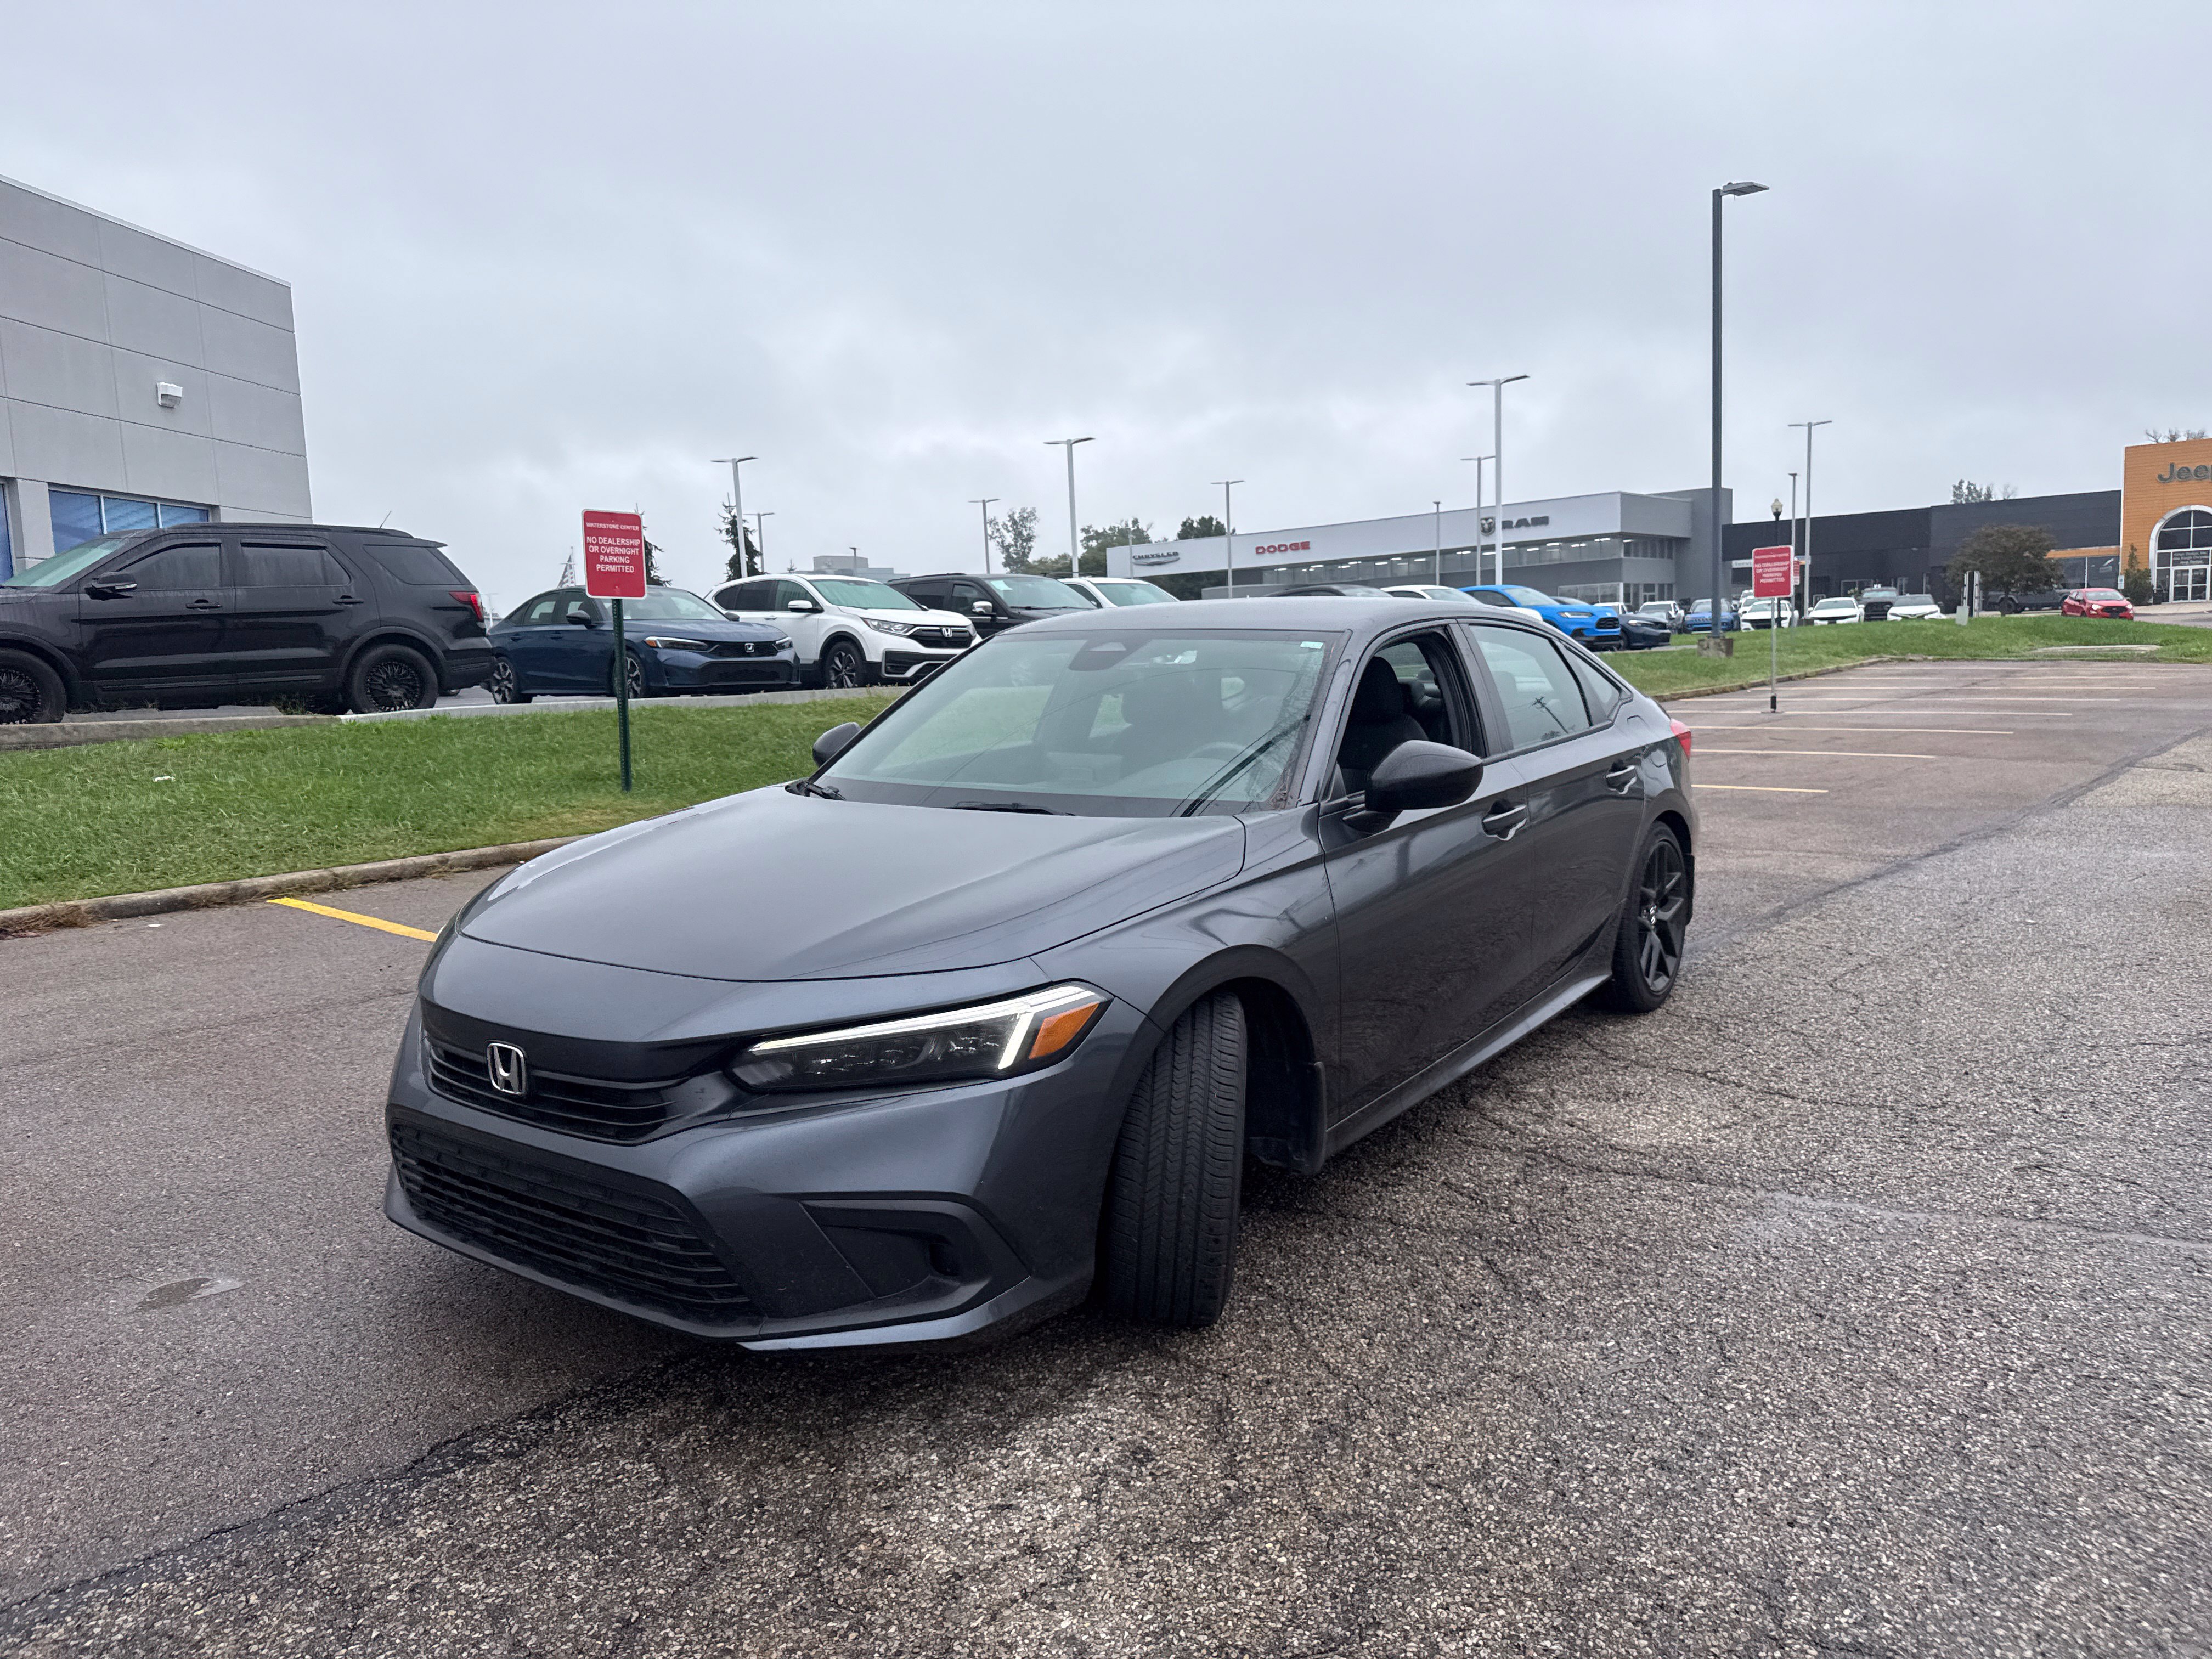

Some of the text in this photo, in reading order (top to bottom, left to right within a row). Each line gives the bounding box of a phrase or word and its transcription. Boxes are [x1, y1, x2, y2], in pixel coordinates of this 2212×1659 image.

[2157, 462, 2212, 483] Jee
[1502, 516, 1549, 529] RAM
[599, 537, 641, 546] DEALERSHIP
[589, 545, 640, 555] OR OVERNIGHT
[1255, 541, 1311, 554] DODGE
[600, 555, 630, 563] PARKING
[596, 564, 634, 573] PERMITTED
